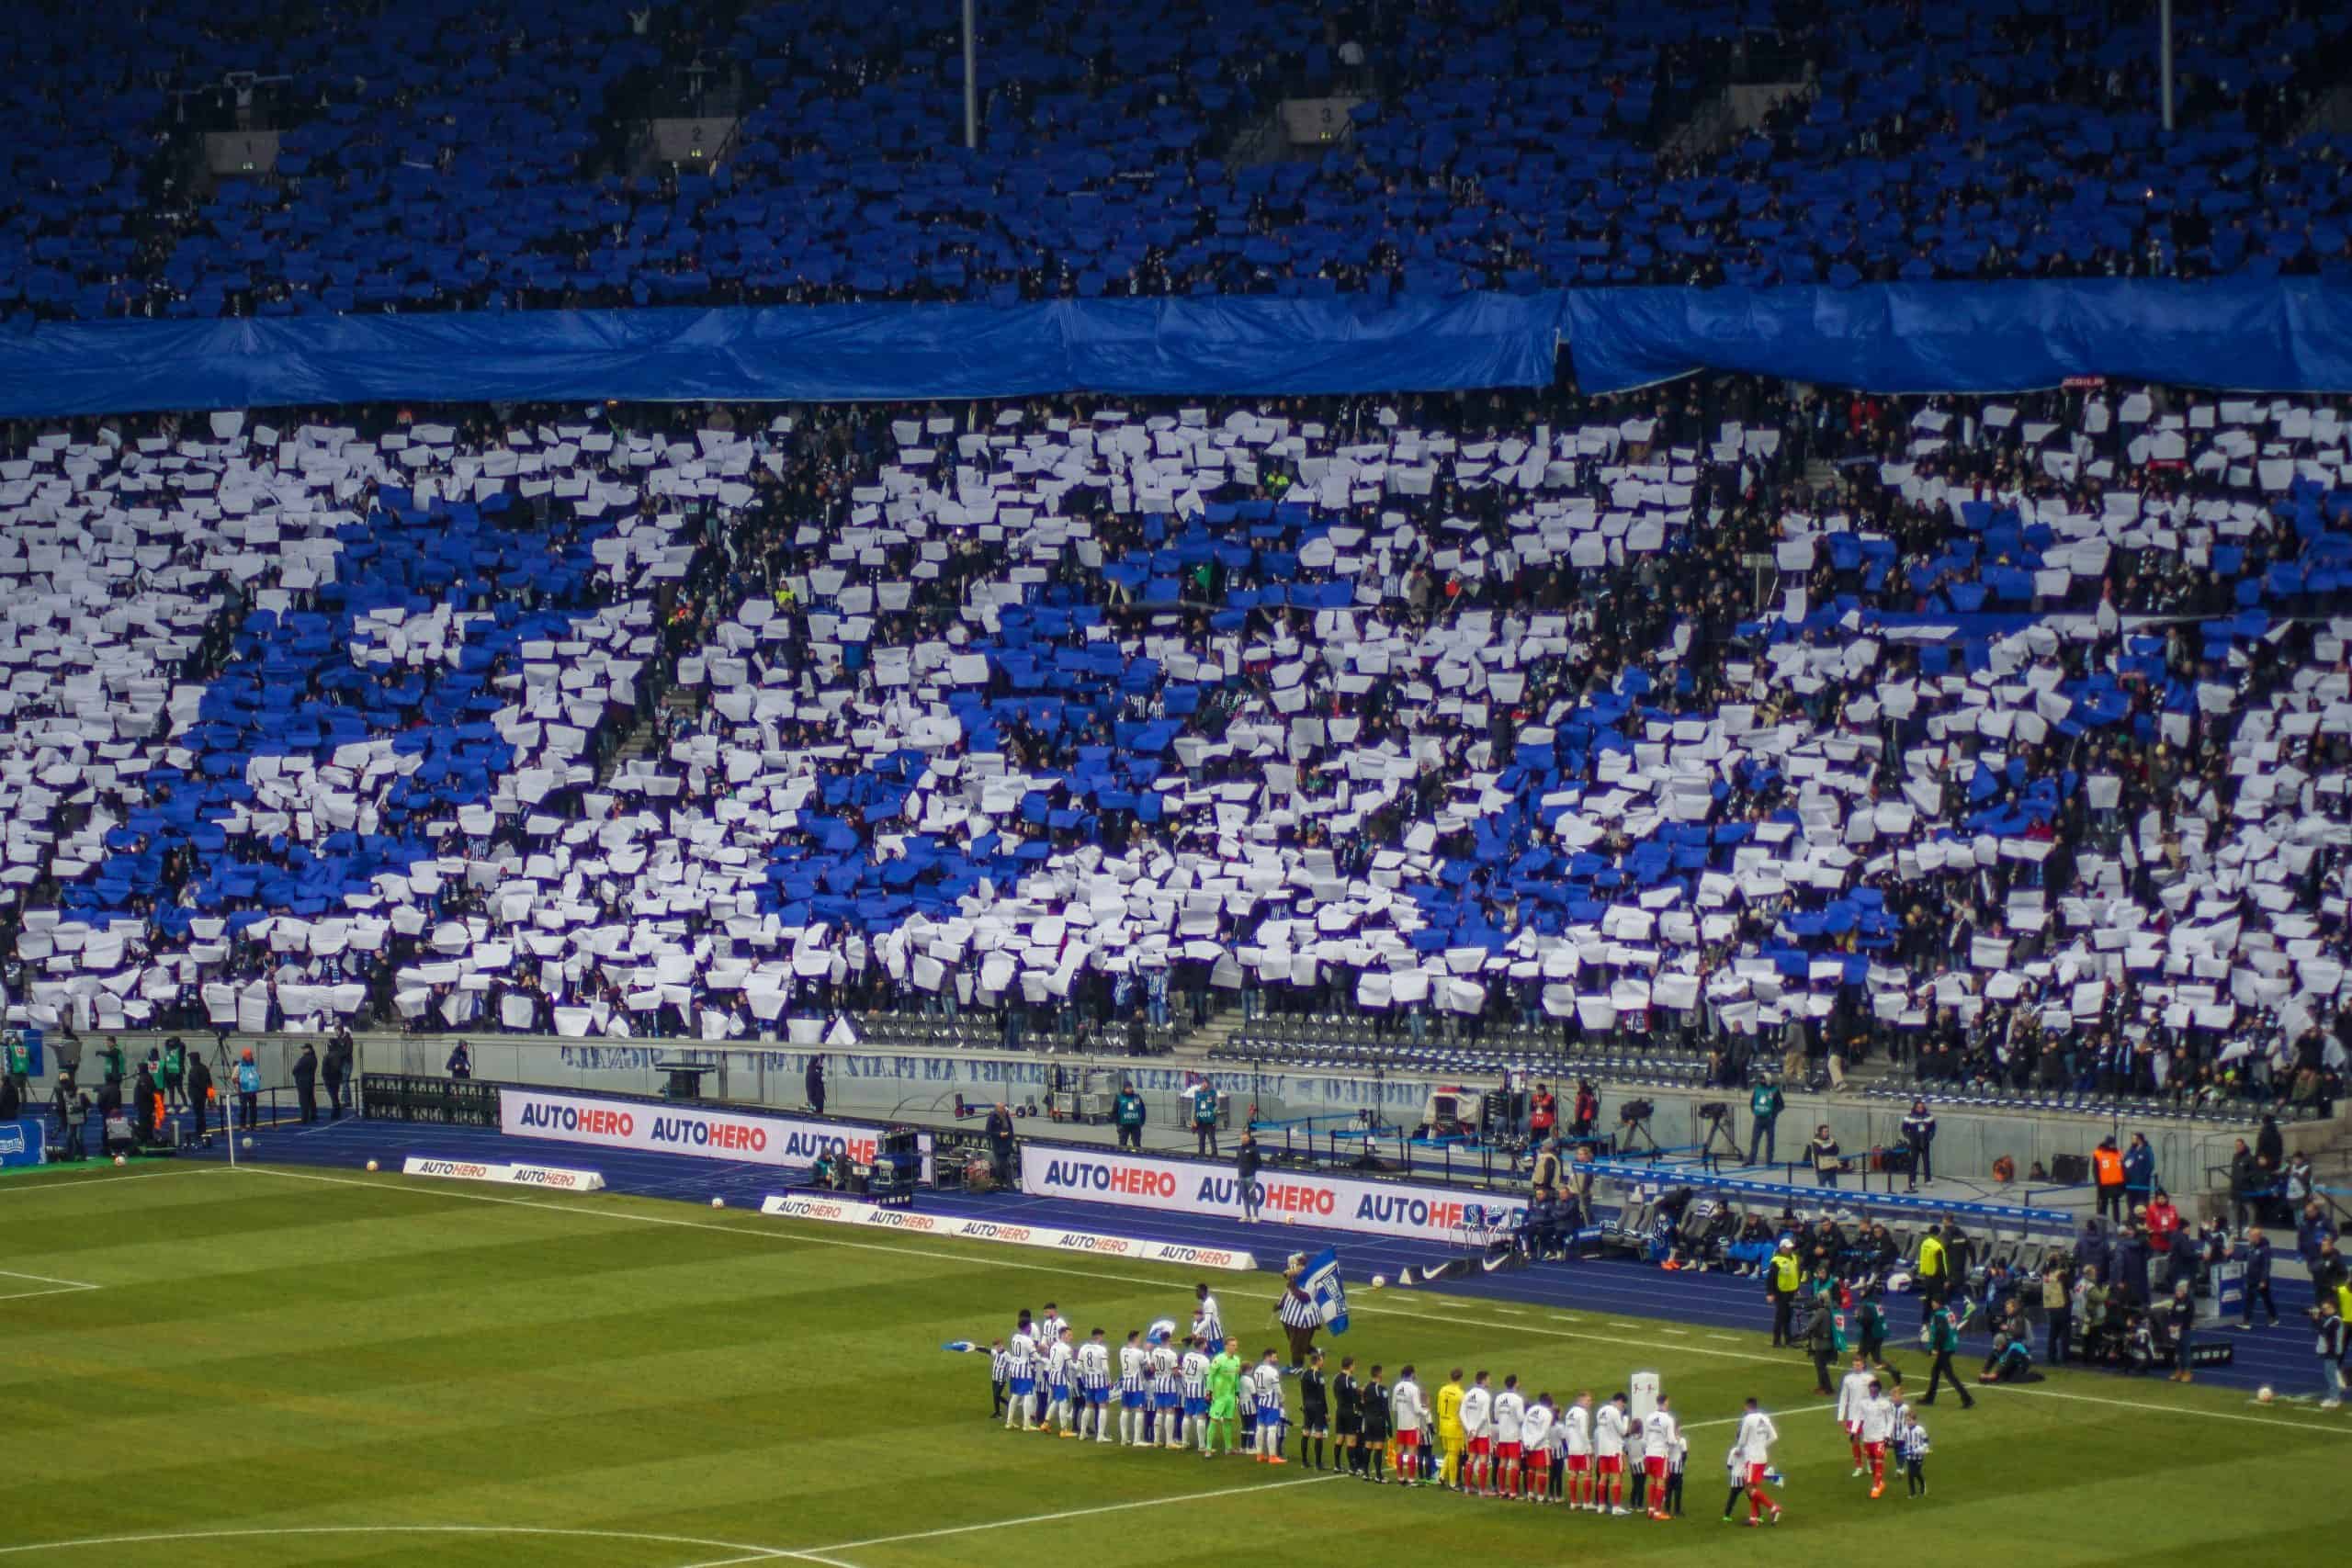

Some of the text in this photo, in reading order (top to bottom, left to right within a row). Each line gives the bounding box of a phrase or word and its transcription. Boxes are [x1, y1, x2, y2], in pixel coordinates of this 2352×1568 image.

[1322, 107, 1331, 123] 3
[691, 125, 701, 142] 2
[520, 1102, 634, 1137] AUTOHERO
[650, 1116, 767, 1152] AUTOHERO
[786, 1131, 876, 1166] AUTOHE
[419, 1161, 487, 1178] AUTOHERO
[514, 1169, 576, 1186] AUTOHERO
[1045, 1160, 1176, 1198] AUTOHERO
[777, 1201, 842, 1218] AUTOHERO
[1356, 1193, 1464, 1228] AUTOHE
[867, 1211, 934, 1229] AUTOHERO
[961, 1222, 1031, 1241] AUTOHERO
[1058, 1234, 1128, 1253] AUTOHERO
[1158, 1246, 1232, 1266] AUTOHERO
[1012, 1340, 1022, 1359] 10
[1051, 1347, 1057, 1366] 2
[1087, 1351, 1093, 1368] 8
[1124, 1355, 1130, 1371] 5
[1154, 1356, 1166, 1372] 20
[1186, 1359, 1198, 1376] 29
[1255, 1371, 1265, 1390] 21
[1443, 1398, 1450, 1416] 1
